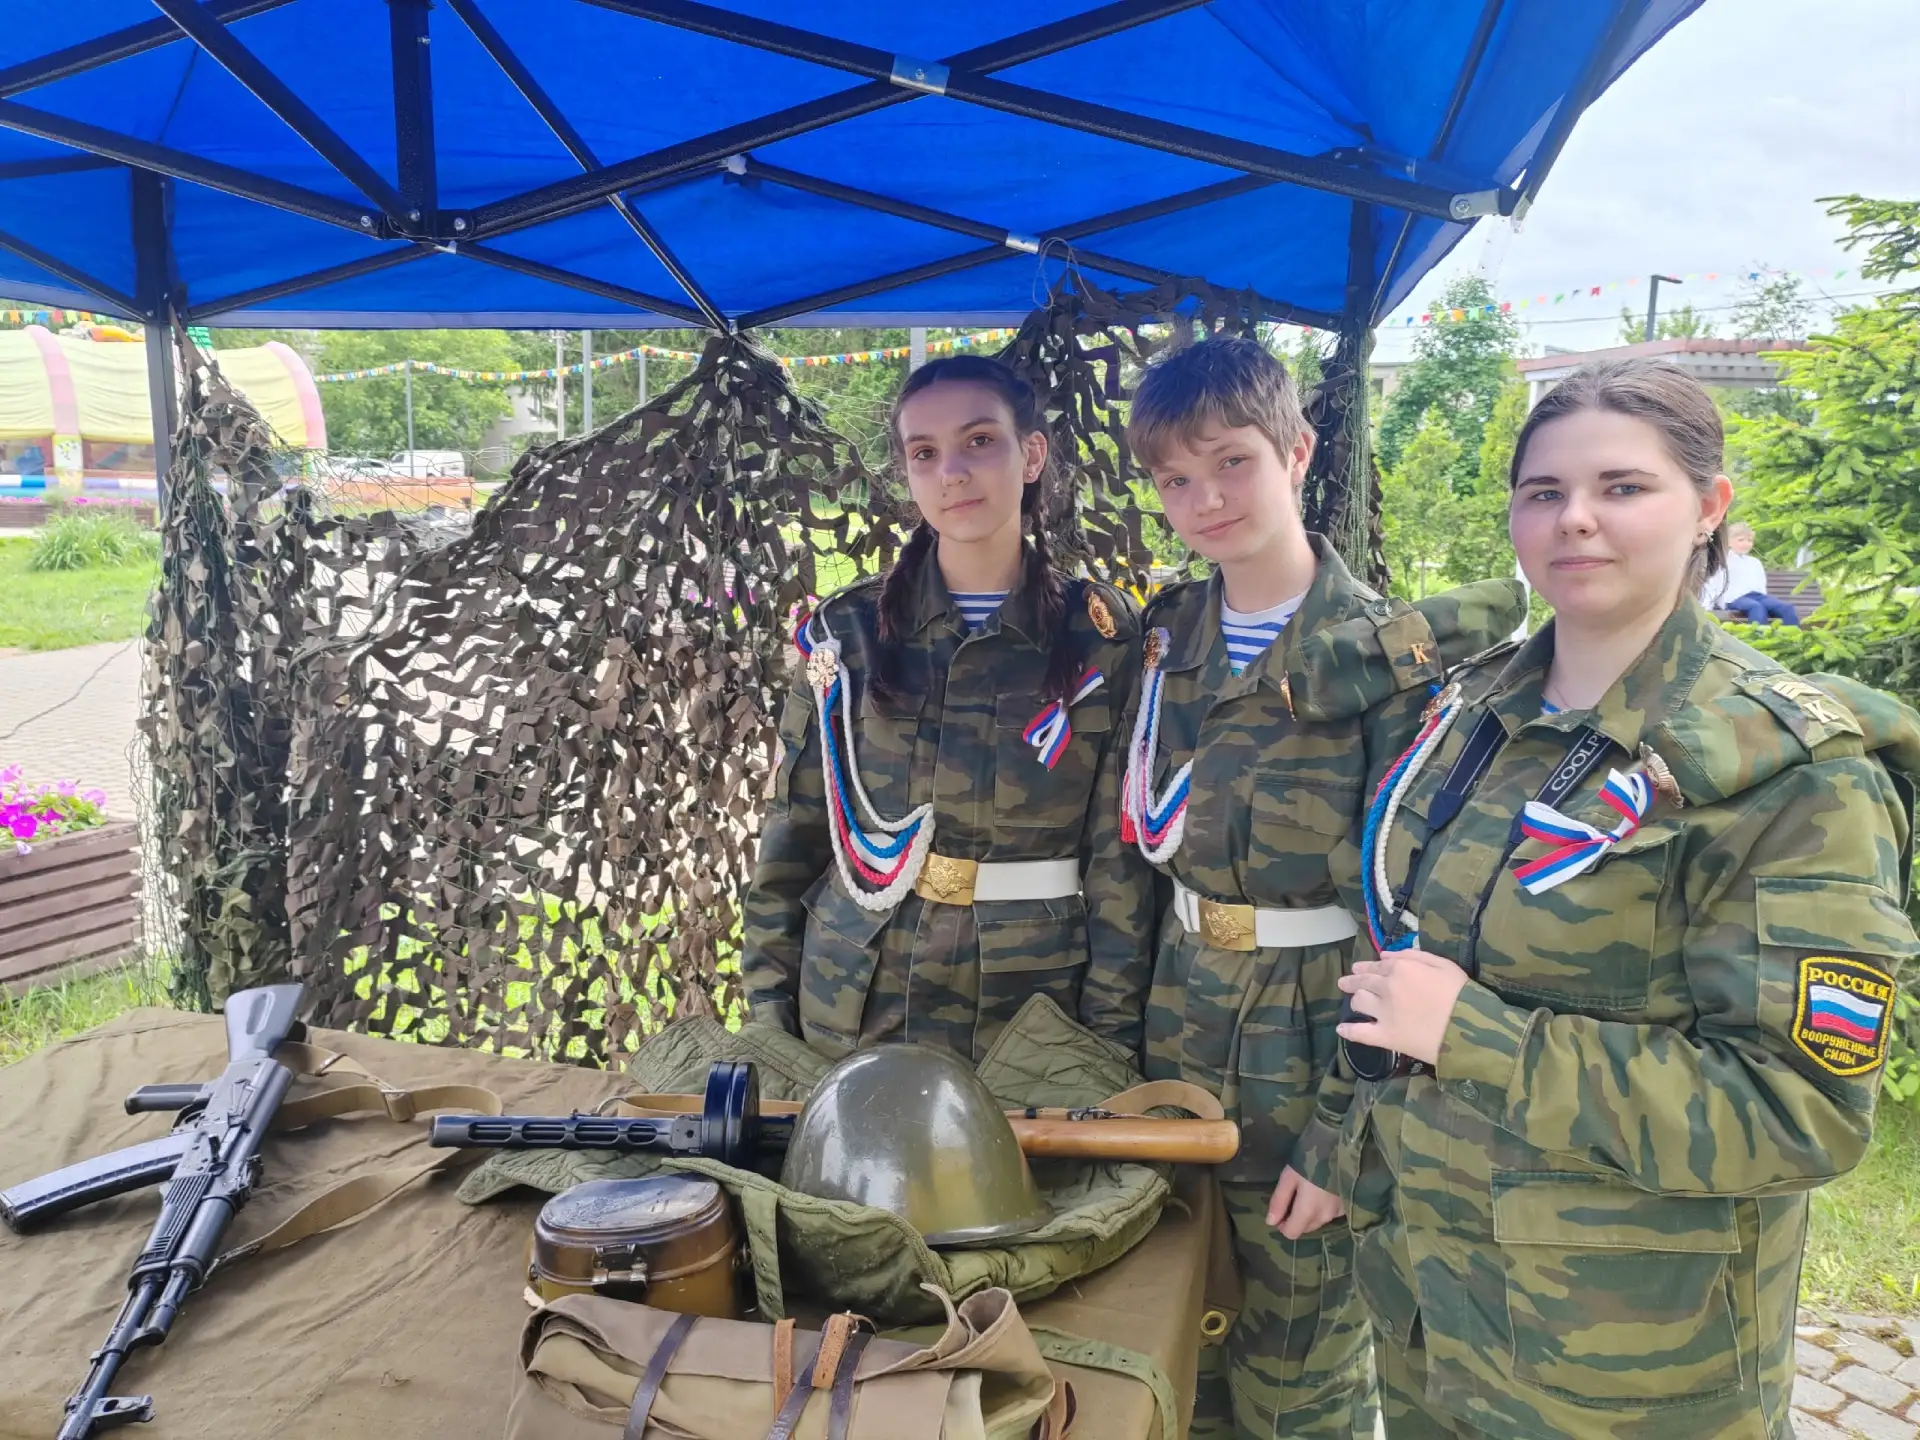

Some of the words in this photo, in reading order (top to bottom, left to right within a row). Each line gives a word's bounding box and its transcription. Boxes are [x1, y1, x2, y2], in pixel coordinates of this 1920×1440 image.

[1808, 967, 1890, 1000] РОССИЯ
[1801, 1029, 1877, 1058] ВООРУЖЕННЫЕ
[1823, 1048, 1856, 1065] СИЛЫ
